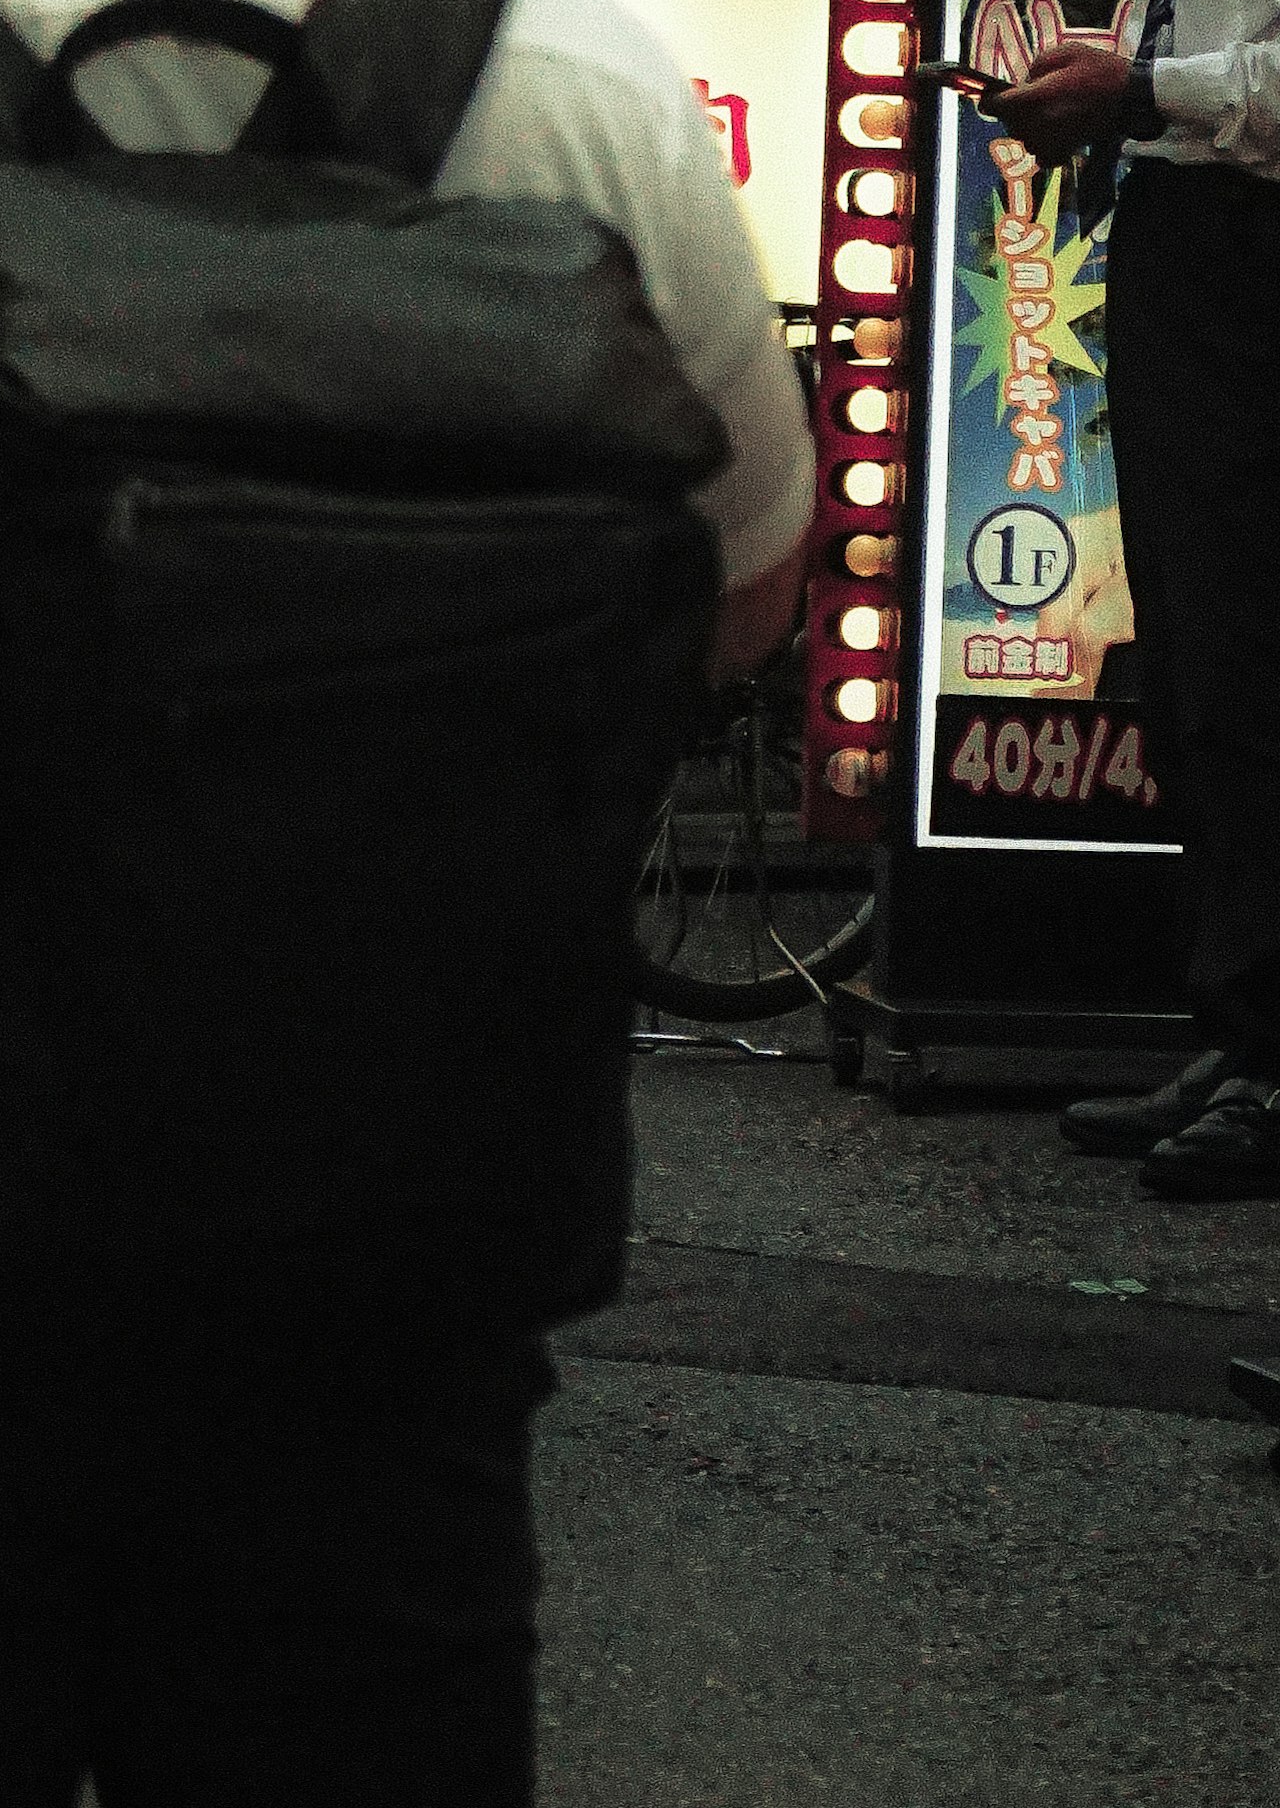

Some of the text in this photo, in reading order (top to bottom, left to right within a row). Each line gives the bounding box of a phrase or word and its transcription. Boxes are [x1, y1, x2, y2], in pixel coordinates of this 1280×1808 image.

[989, 138, 1063, 491] ツーショットキャバ
[991, 525, 1058, 587] 1F
[964, 634, 1073, 681] 前金制
